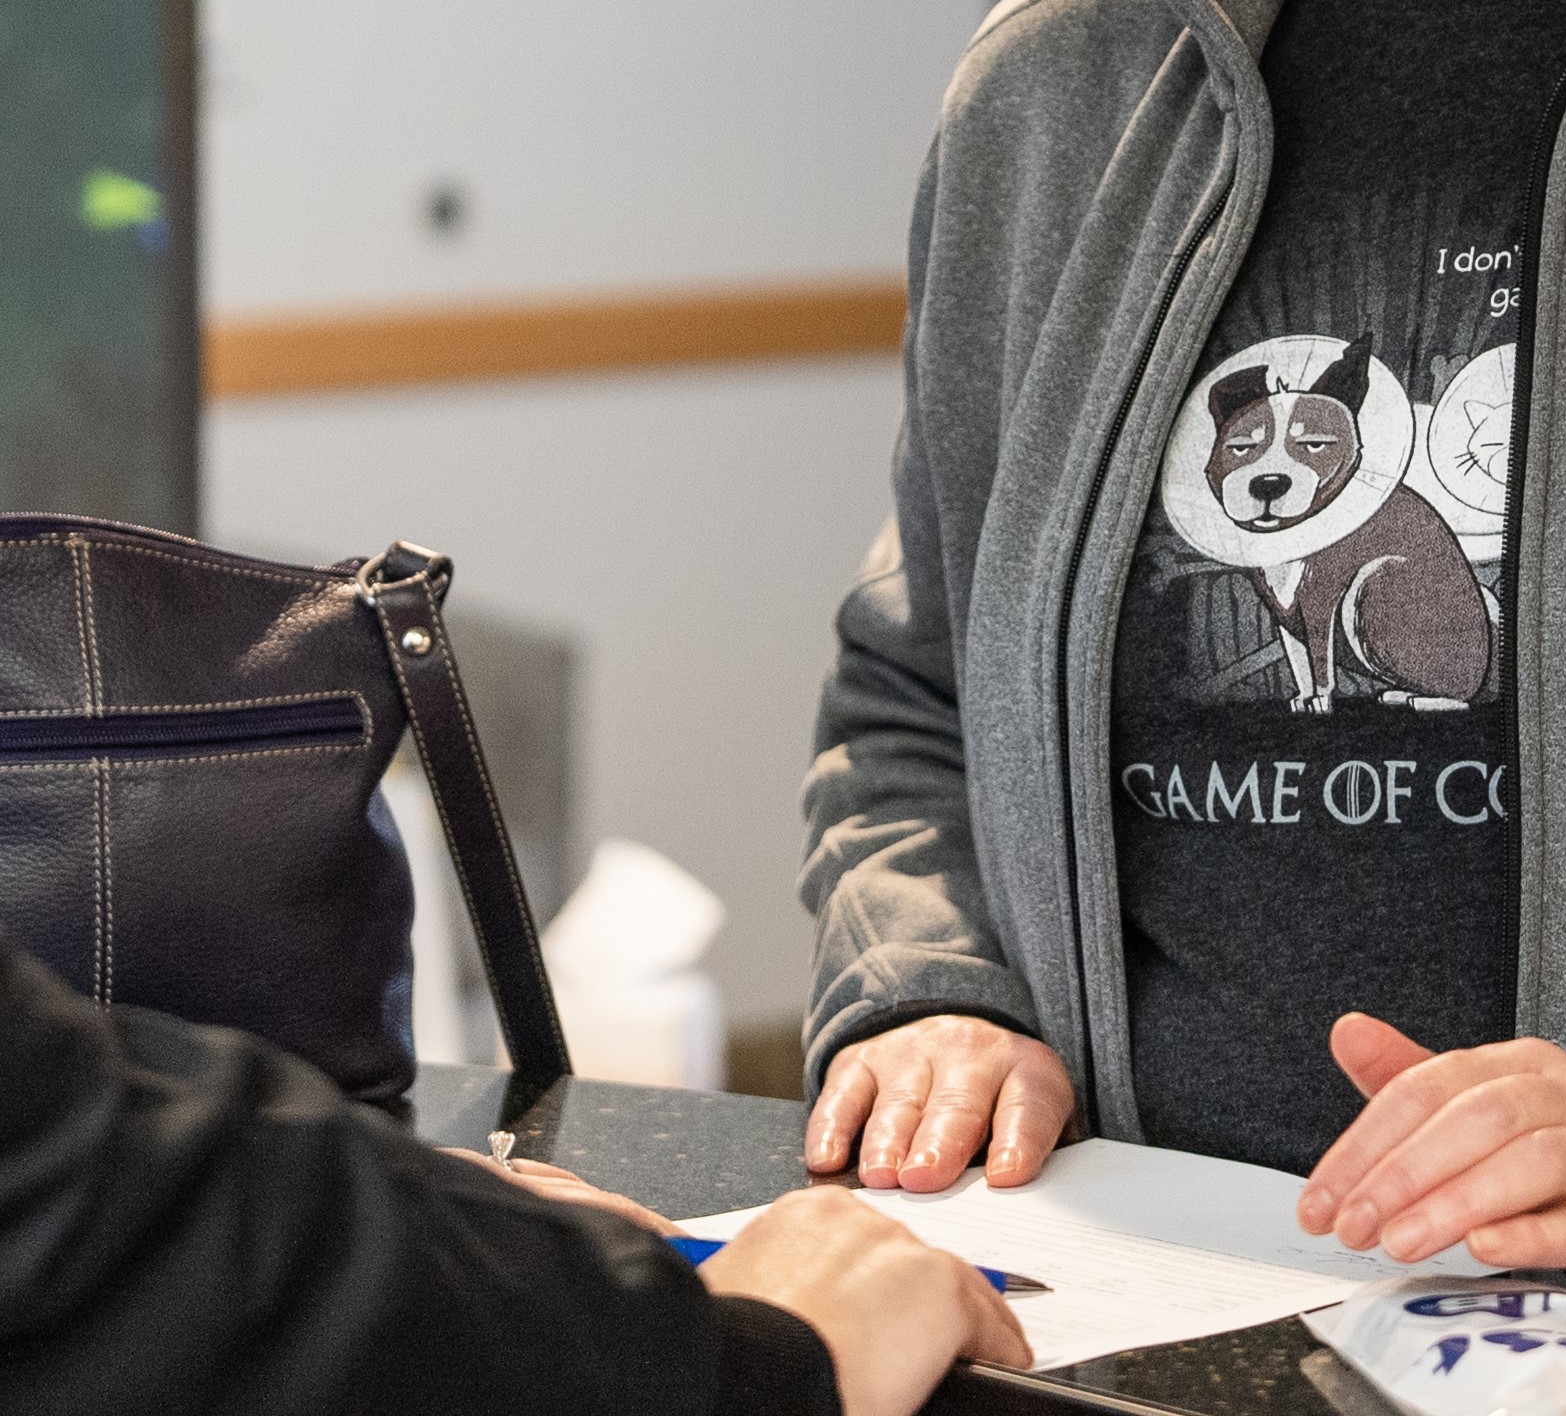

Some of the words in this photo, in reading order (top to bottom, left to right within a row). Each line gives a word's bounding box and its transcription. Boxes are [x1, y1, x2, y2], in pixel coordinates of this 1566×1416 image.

[1436, 248, 1448, 274] I
[1453, 245, 1523, 273] don'
[1121, 760, 1307, 825] GAME
[1322, 760, 1417, 826] OF
